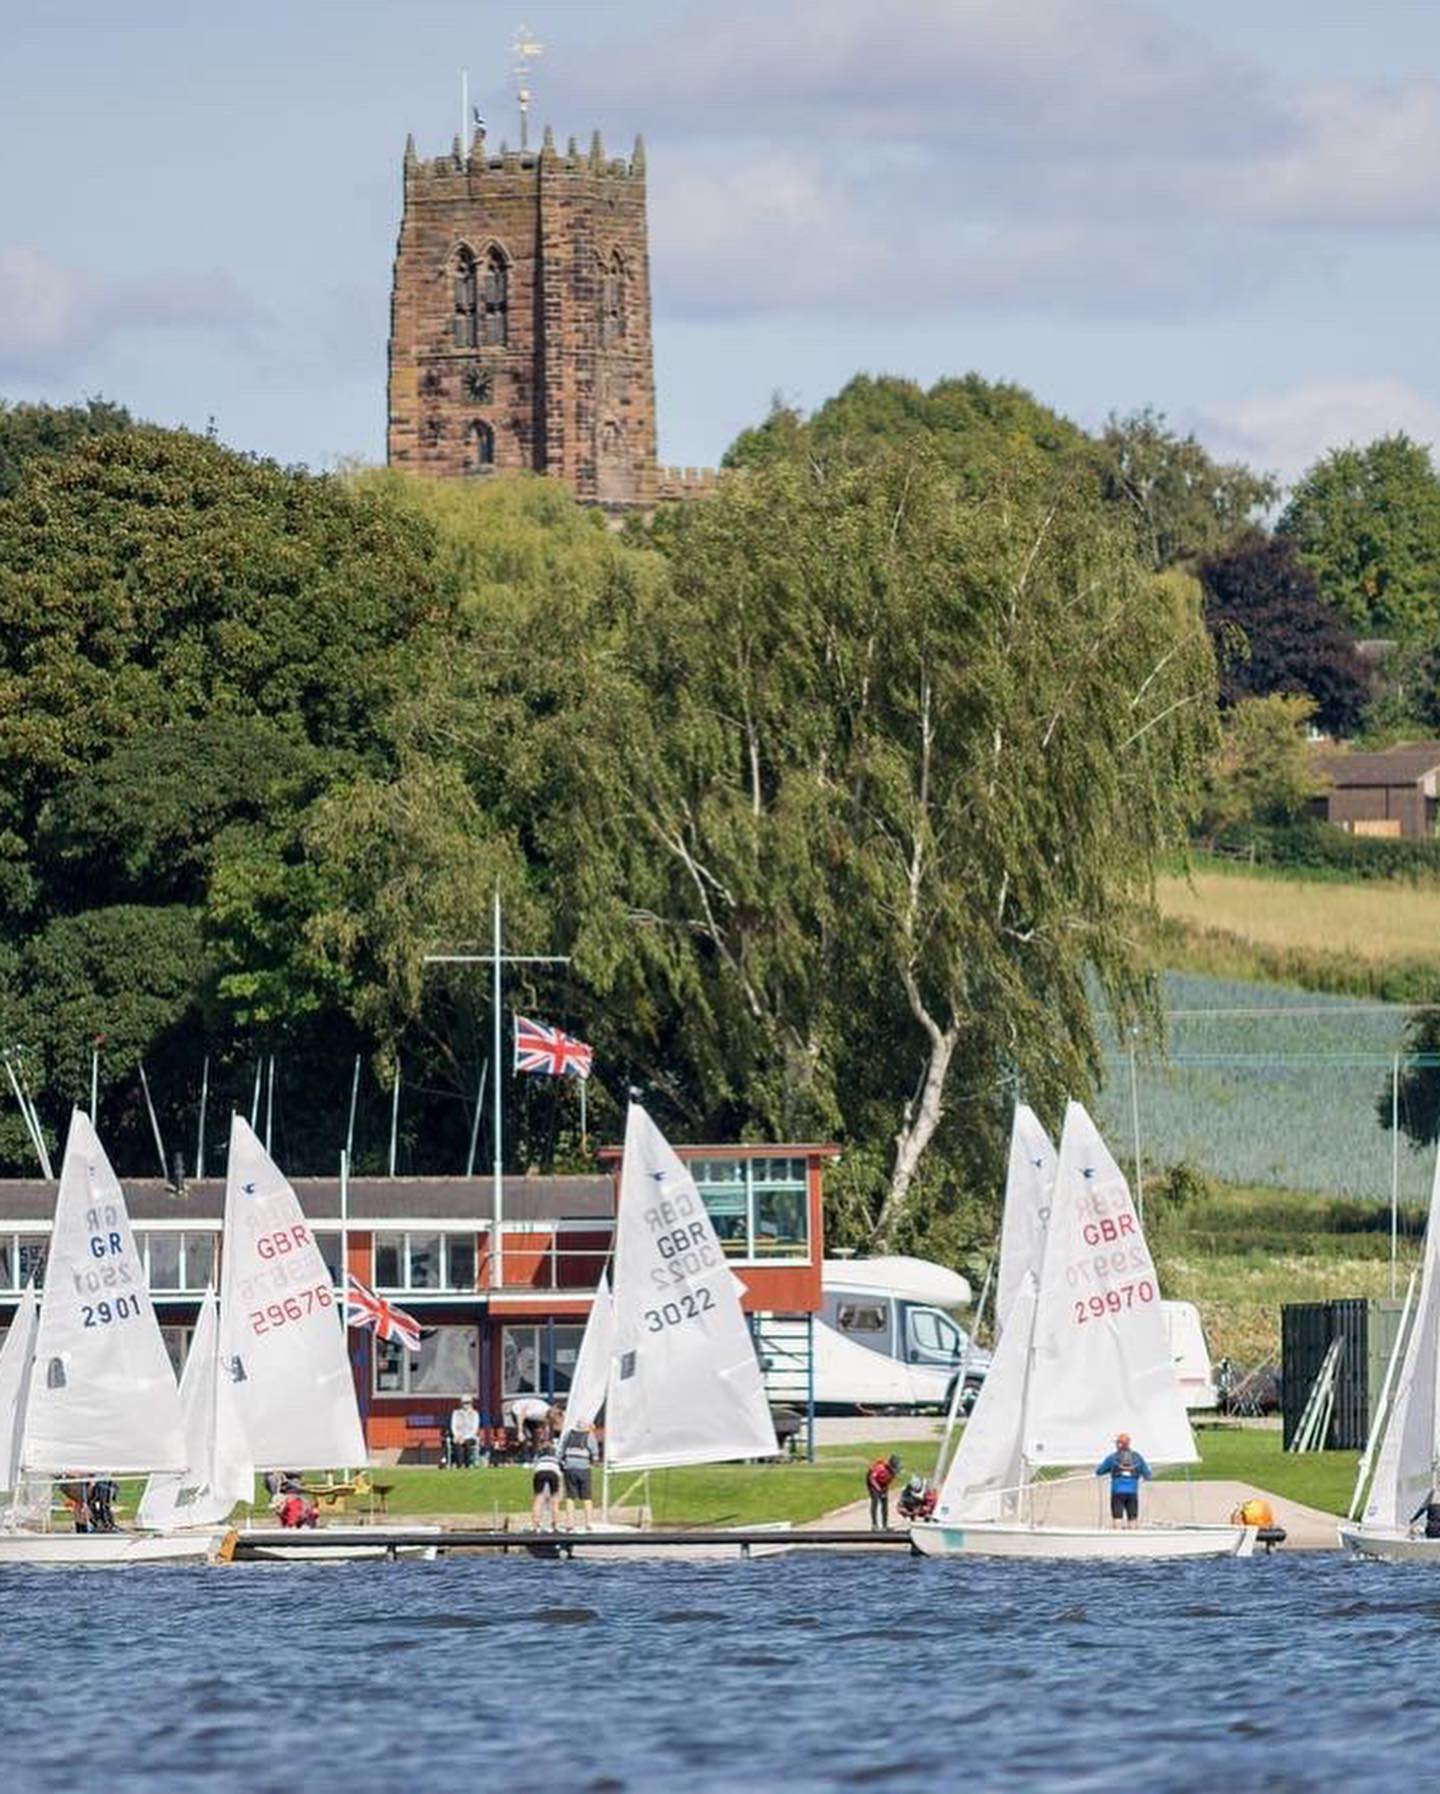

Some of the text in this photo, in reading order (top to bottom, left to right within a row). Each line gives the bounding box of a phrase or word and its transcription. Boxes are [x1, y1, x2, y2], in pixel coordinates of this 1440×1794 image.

[90, 1232, 123, 1258] GR
[257, 1225, 311, 1259] GBR
[657, 1221, 707, 1259] GBR
[1083, 1214, 1136, 1246] GBR
[81, 1294, 141, 1327] 2901
[250, 1285, 333, 1334] 29676
[644, 1287, 716, 1333] 3022
[1074, 1281, 1153, 1324] 29970
